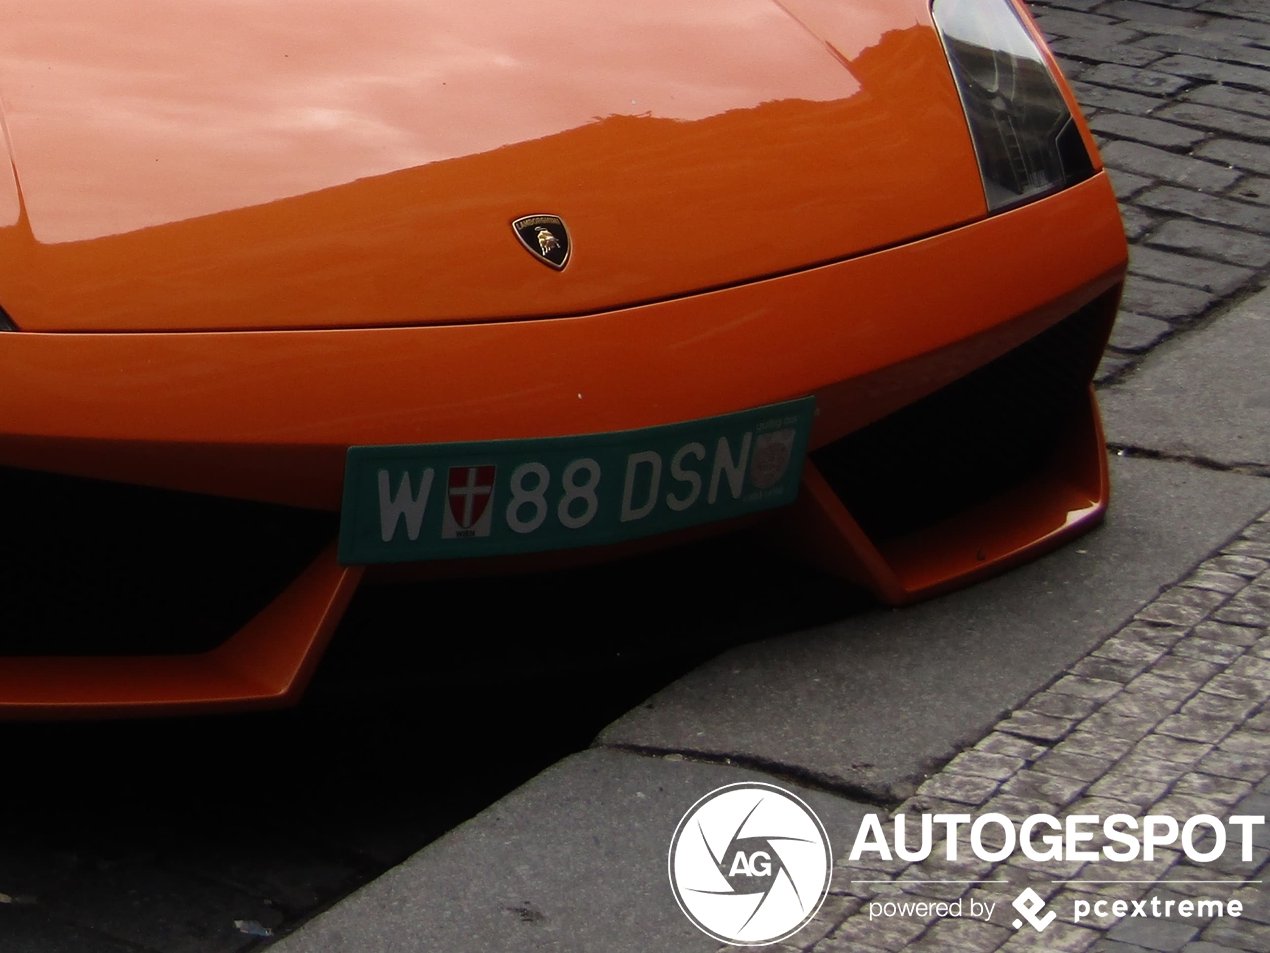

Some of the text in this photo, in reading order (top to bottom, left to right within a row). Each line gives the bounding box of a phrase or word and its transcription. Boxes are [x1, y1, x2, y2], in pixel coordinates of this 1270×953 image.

[378, 432, 753, 541] W 88 DSN
